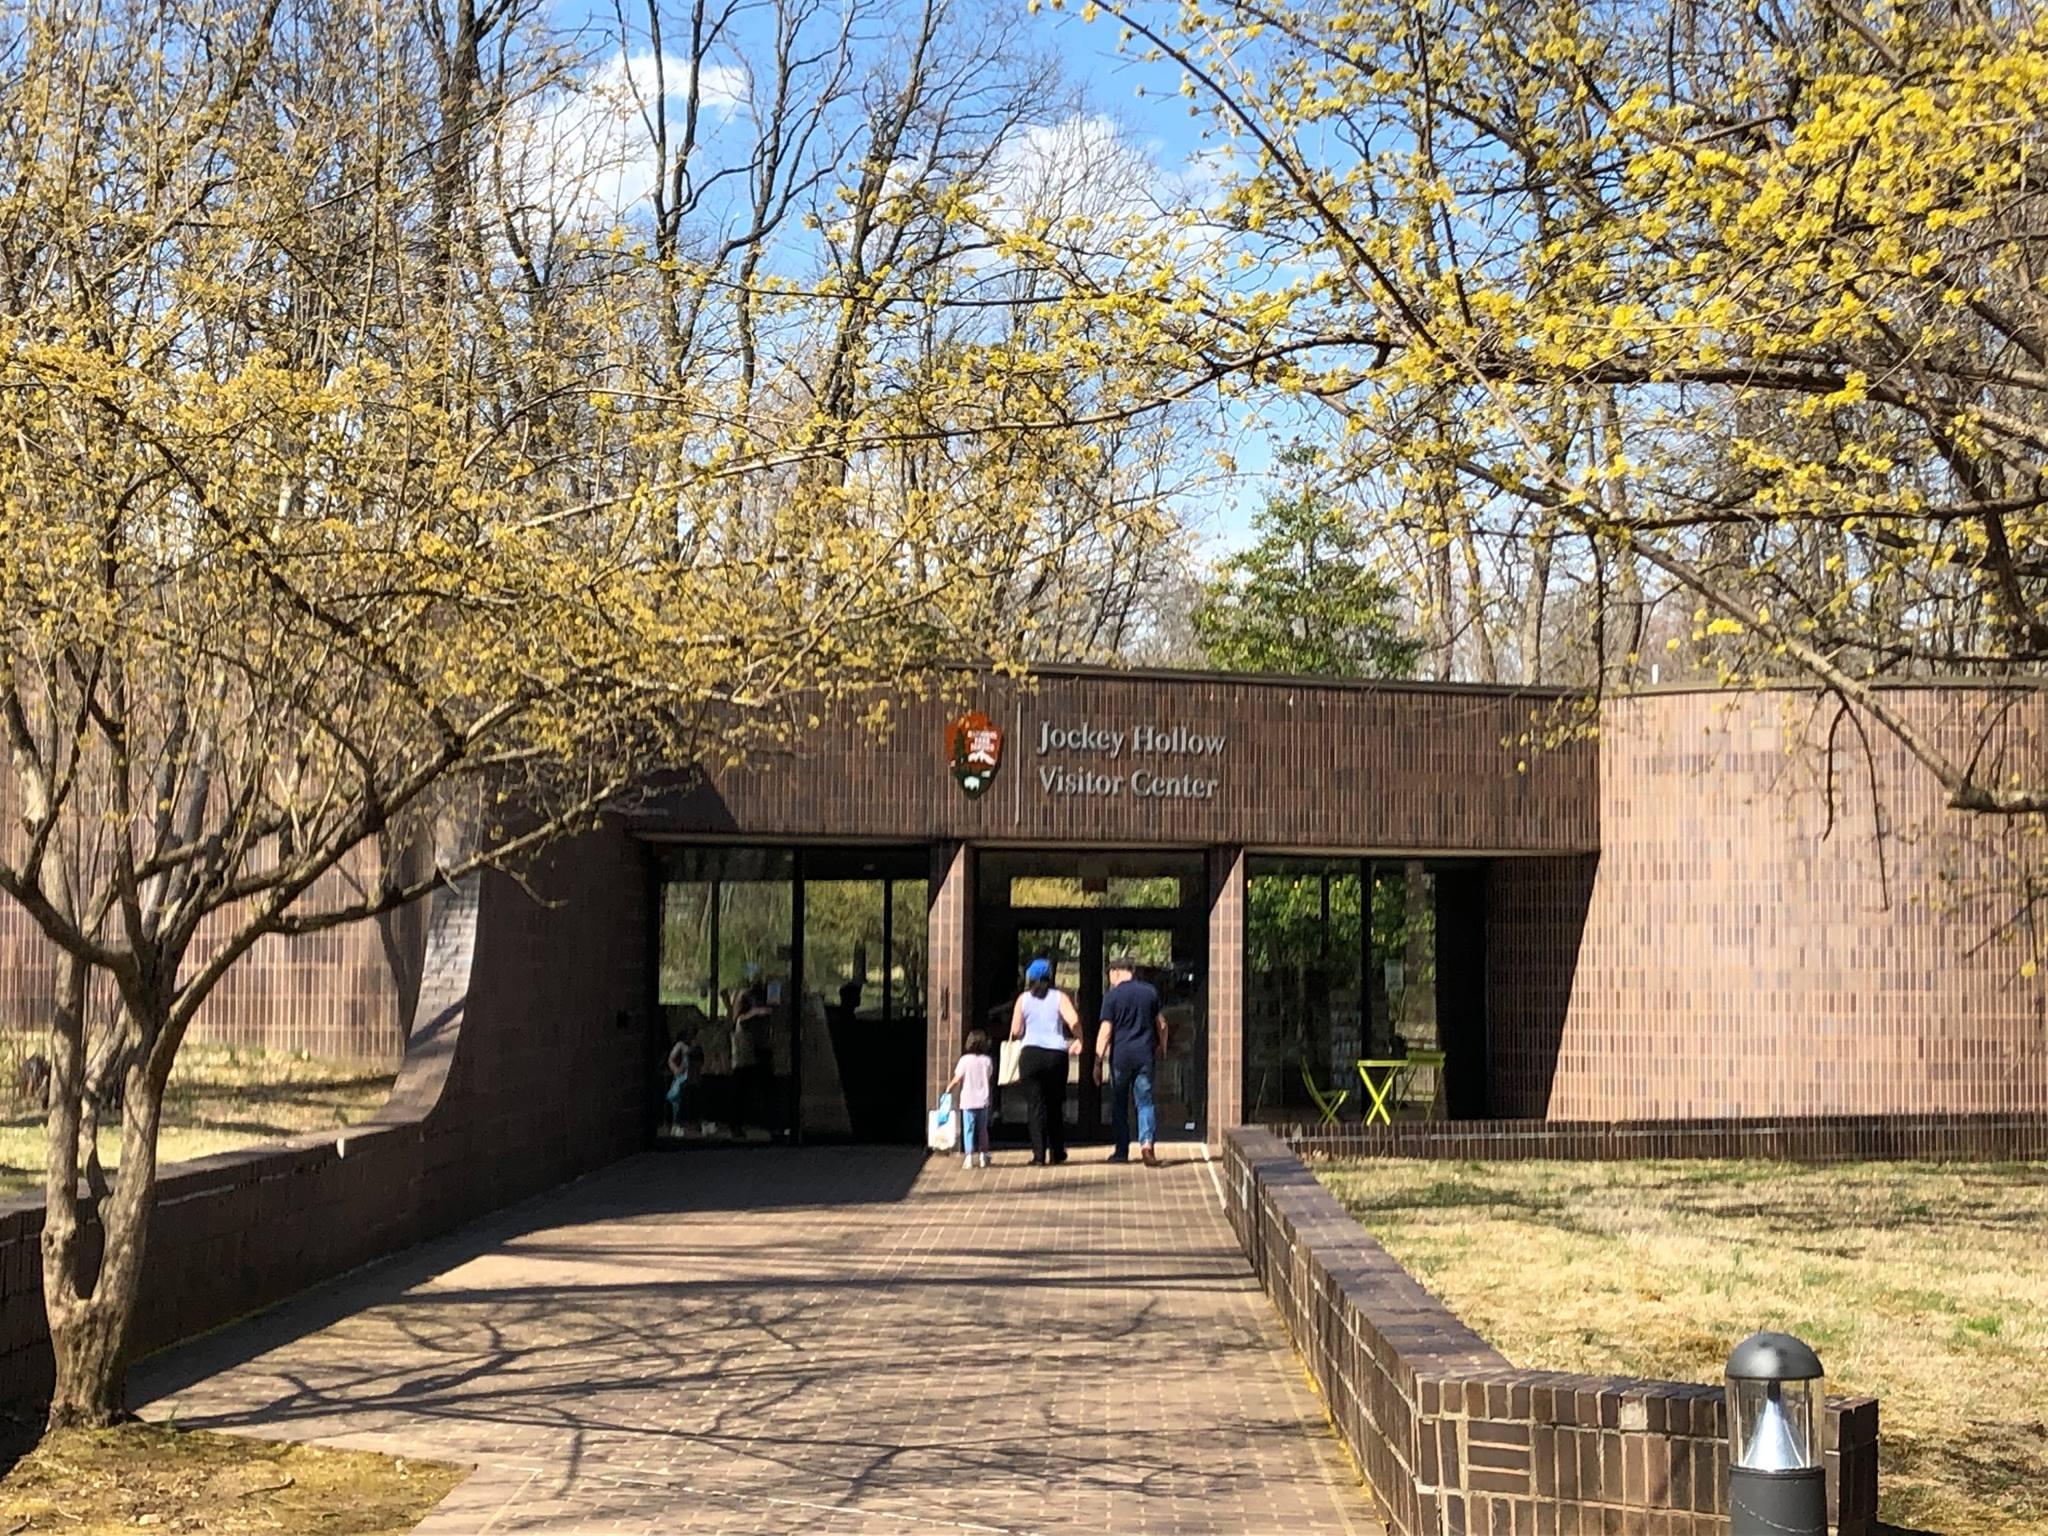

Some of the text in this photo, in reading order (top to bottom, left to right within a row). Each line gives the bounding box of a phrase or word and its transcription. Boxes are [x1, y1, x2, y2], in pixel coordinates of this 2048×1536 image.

[1037, 720, 1227, 758] Jockey Hollow
[1038, 765, 1219, 799] Visitor Center
